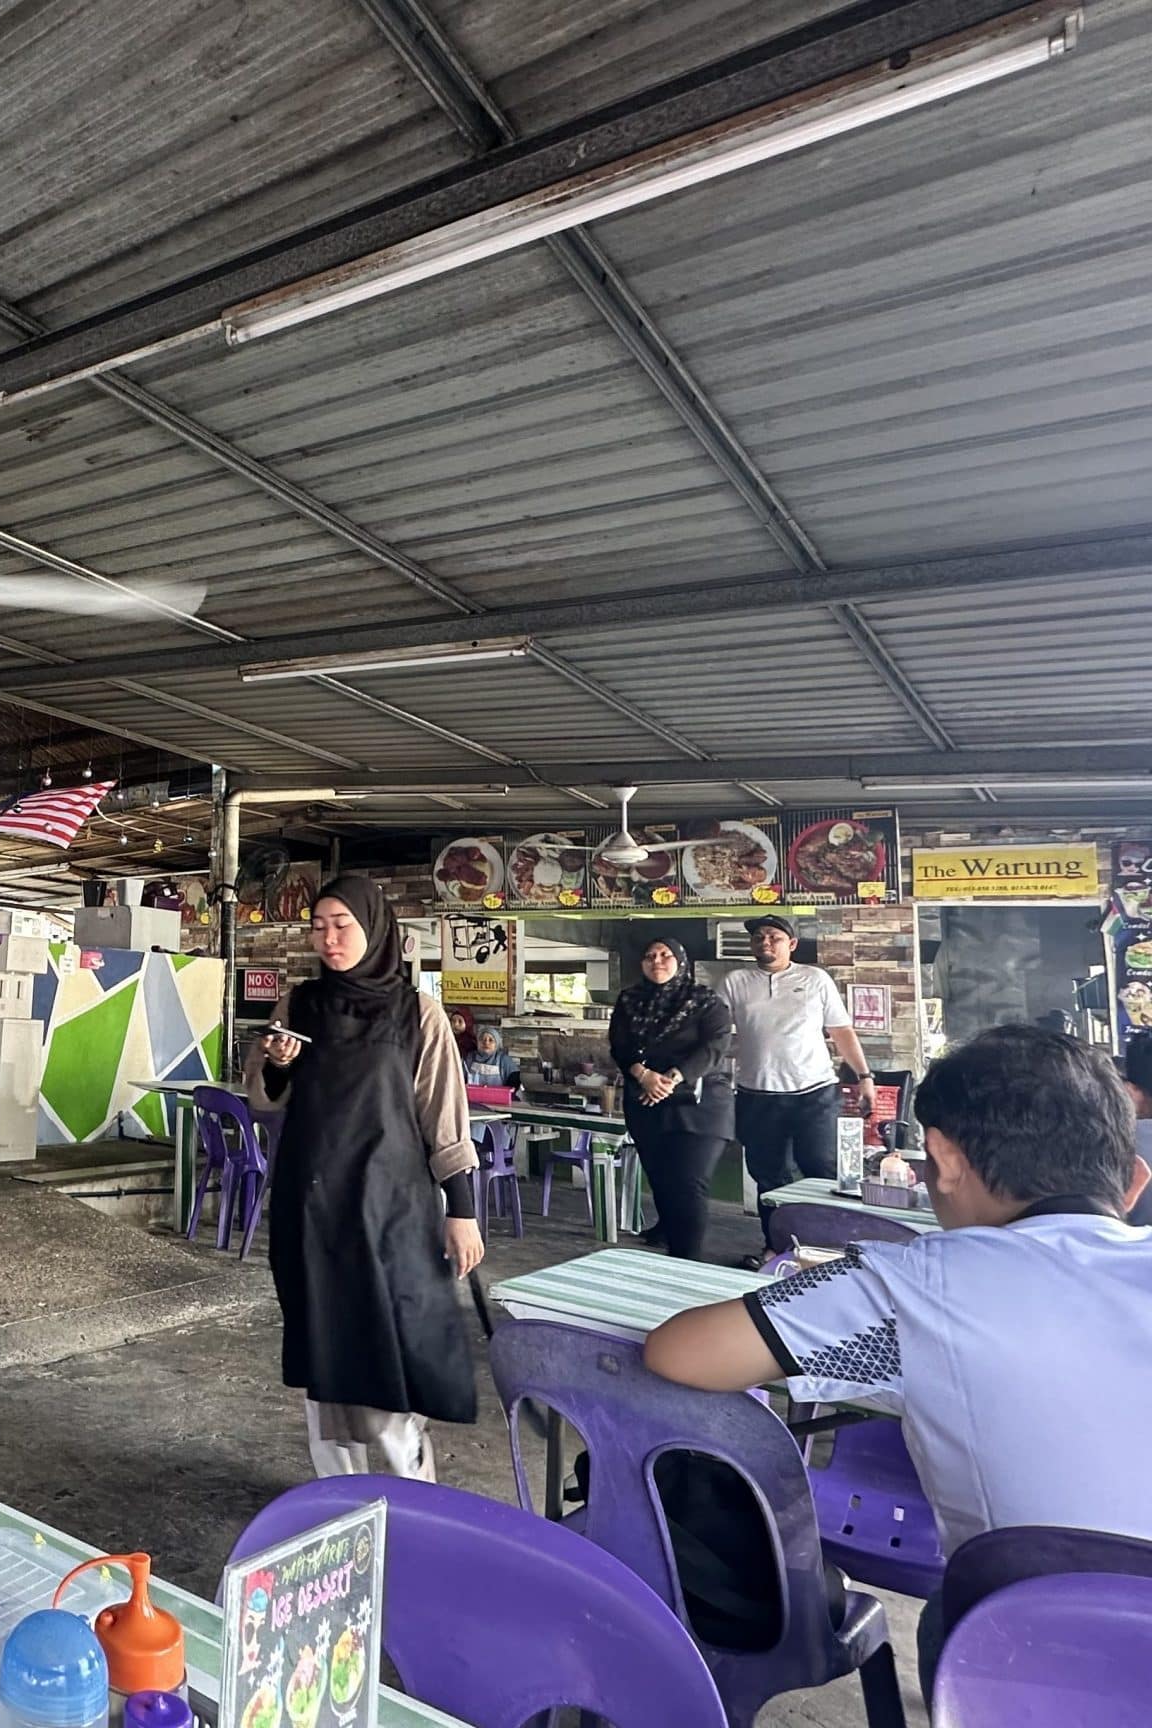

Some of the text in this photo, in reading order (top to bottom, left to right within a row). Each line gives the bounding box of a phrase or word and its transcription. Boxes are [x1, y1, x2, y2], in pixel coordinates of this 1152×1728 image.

[918, 857, 1084, 879] The Warung
[809, 893, 833, 902] Ayam
[248, 974, 262, 985] NO
[460, 976, 506, 992] Warung
[248, 987, 275, 997] SMOKING
[271, 1592, 294, 1632] ICE
[297, 1560, 354, 1617] DESSERT
